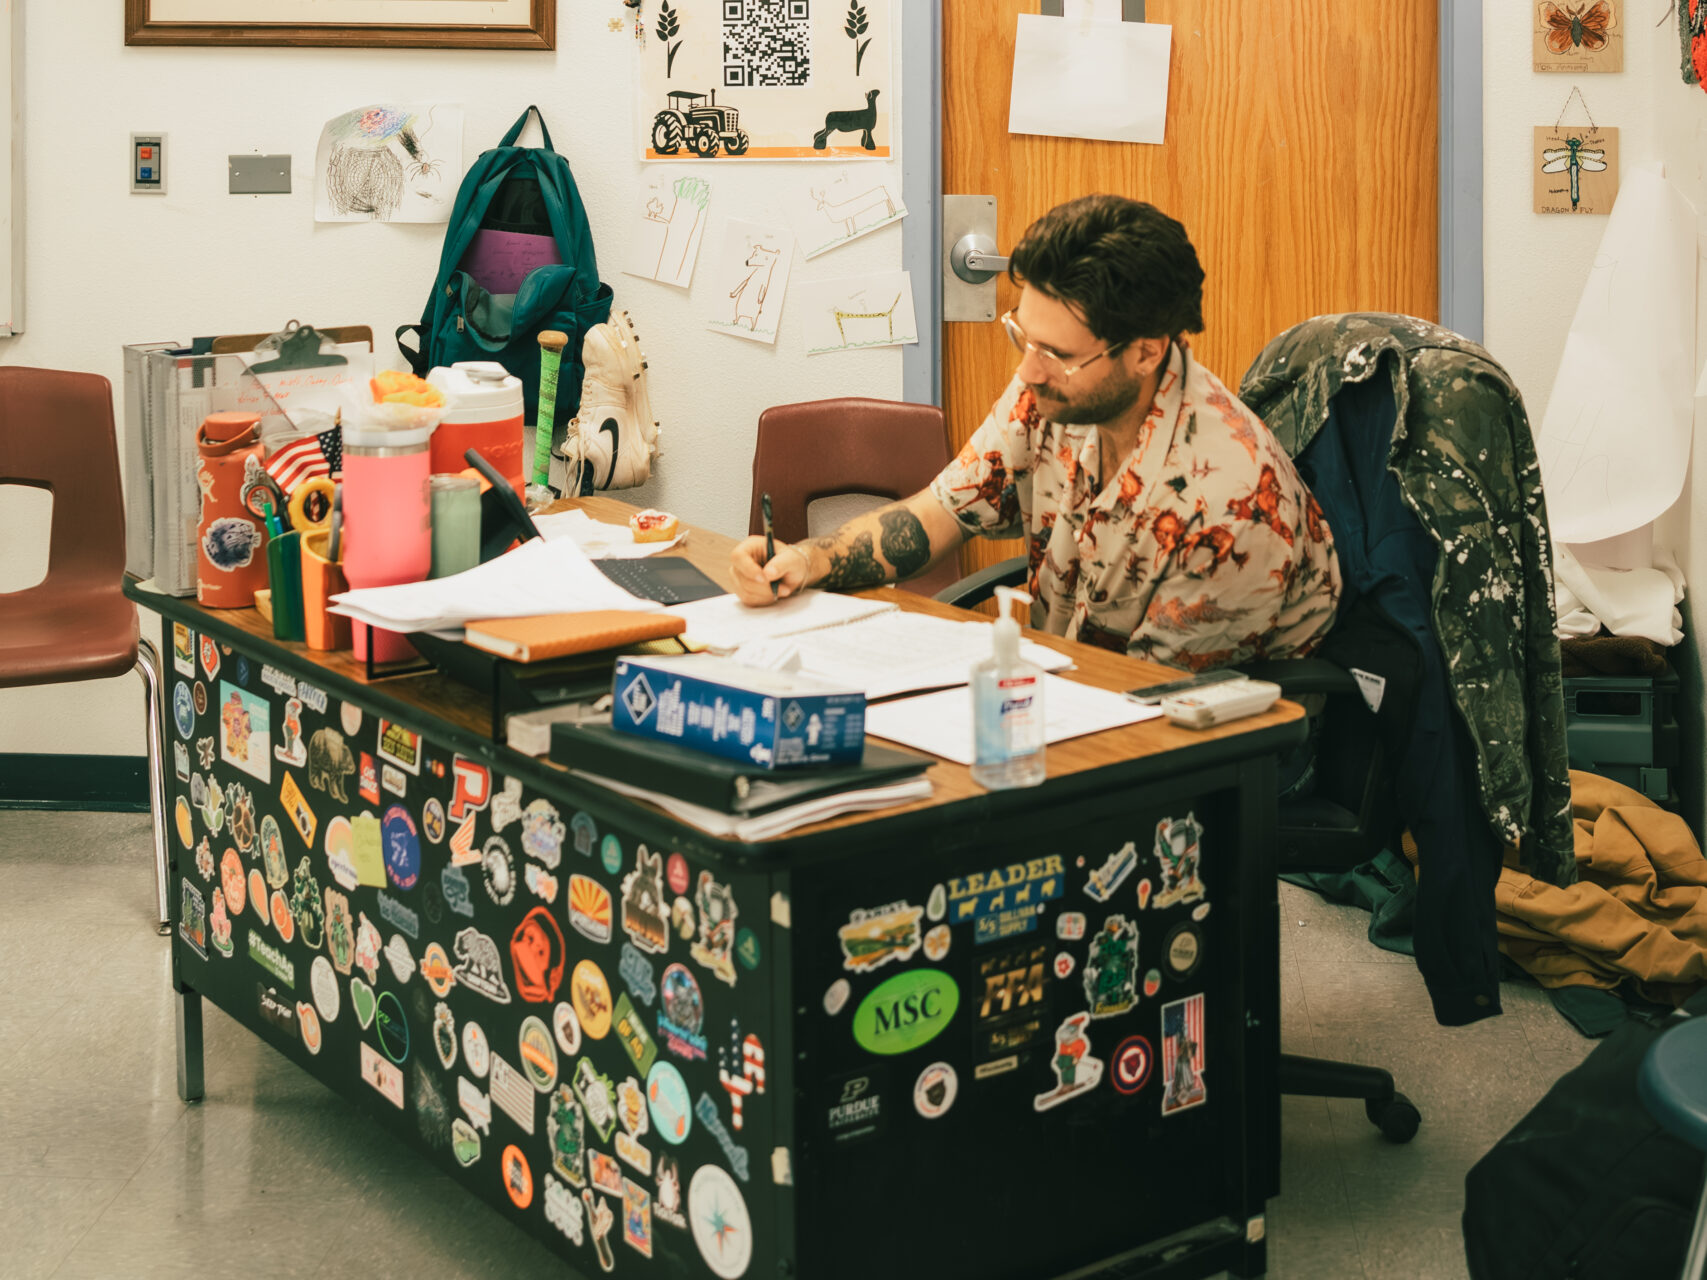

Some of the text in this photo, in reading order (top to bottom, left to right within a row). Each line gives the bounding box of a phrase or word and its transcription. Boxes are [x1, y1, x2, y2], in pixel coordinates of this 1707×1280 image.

[1541, 206, 1594, 214] DRAGON FLY
[948, 854, 1064, 900] LEADER
[874, 988, 942, 1035] MSC
[980, 963, 1044, 1017] FFA
[829, 1095, 880, 1119] PURDUE
